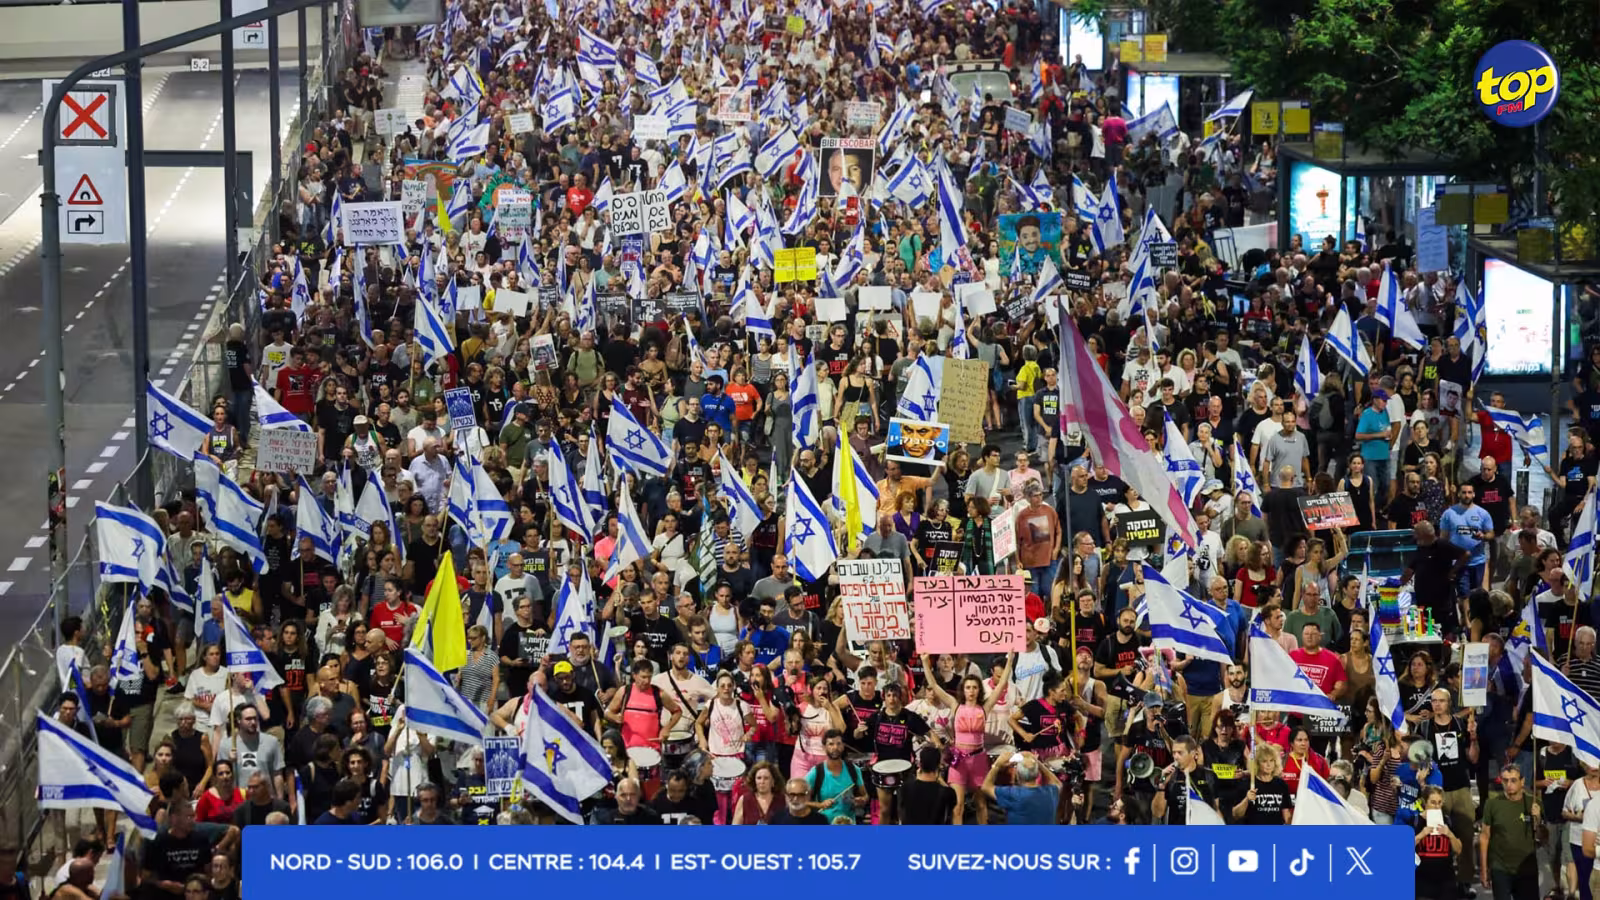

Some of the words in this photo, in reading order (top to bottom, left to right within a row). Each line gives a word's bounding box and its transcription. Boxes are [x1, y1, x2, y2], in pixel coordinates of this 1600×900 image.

[193, 61, 208, 69] 5.2
[822, 139, 837, 147] BIBI
[840, 139, 875, 148] ESCOBAR
[648, 206, 665, 220] גם
[489, 398, 503, 411] לך
[1126, 519, 1156, 532] עסקה
[1126, 528, 1160, 541] עכשיו!
[873, 560, 901, 576] כולנו
[869, 582, 905, 596] עבדים
[918, 579, 950, 590] בעד
[957, 577, 981, 589] נגד
[868, 594, 881, 603] של
[959, 593, 996, 608] הבטחון
[883, 602, 907, 616] רודן
[975, 604, 1015, 617] הבטחון
[855, 615, 899, 634] מסוכן
[861, 629, 888, 640] כשיר
[892, 627, 910, 638] ולא
[979, 630, 1014, 646] העם
[486, 740, 518, 749] בחירות
